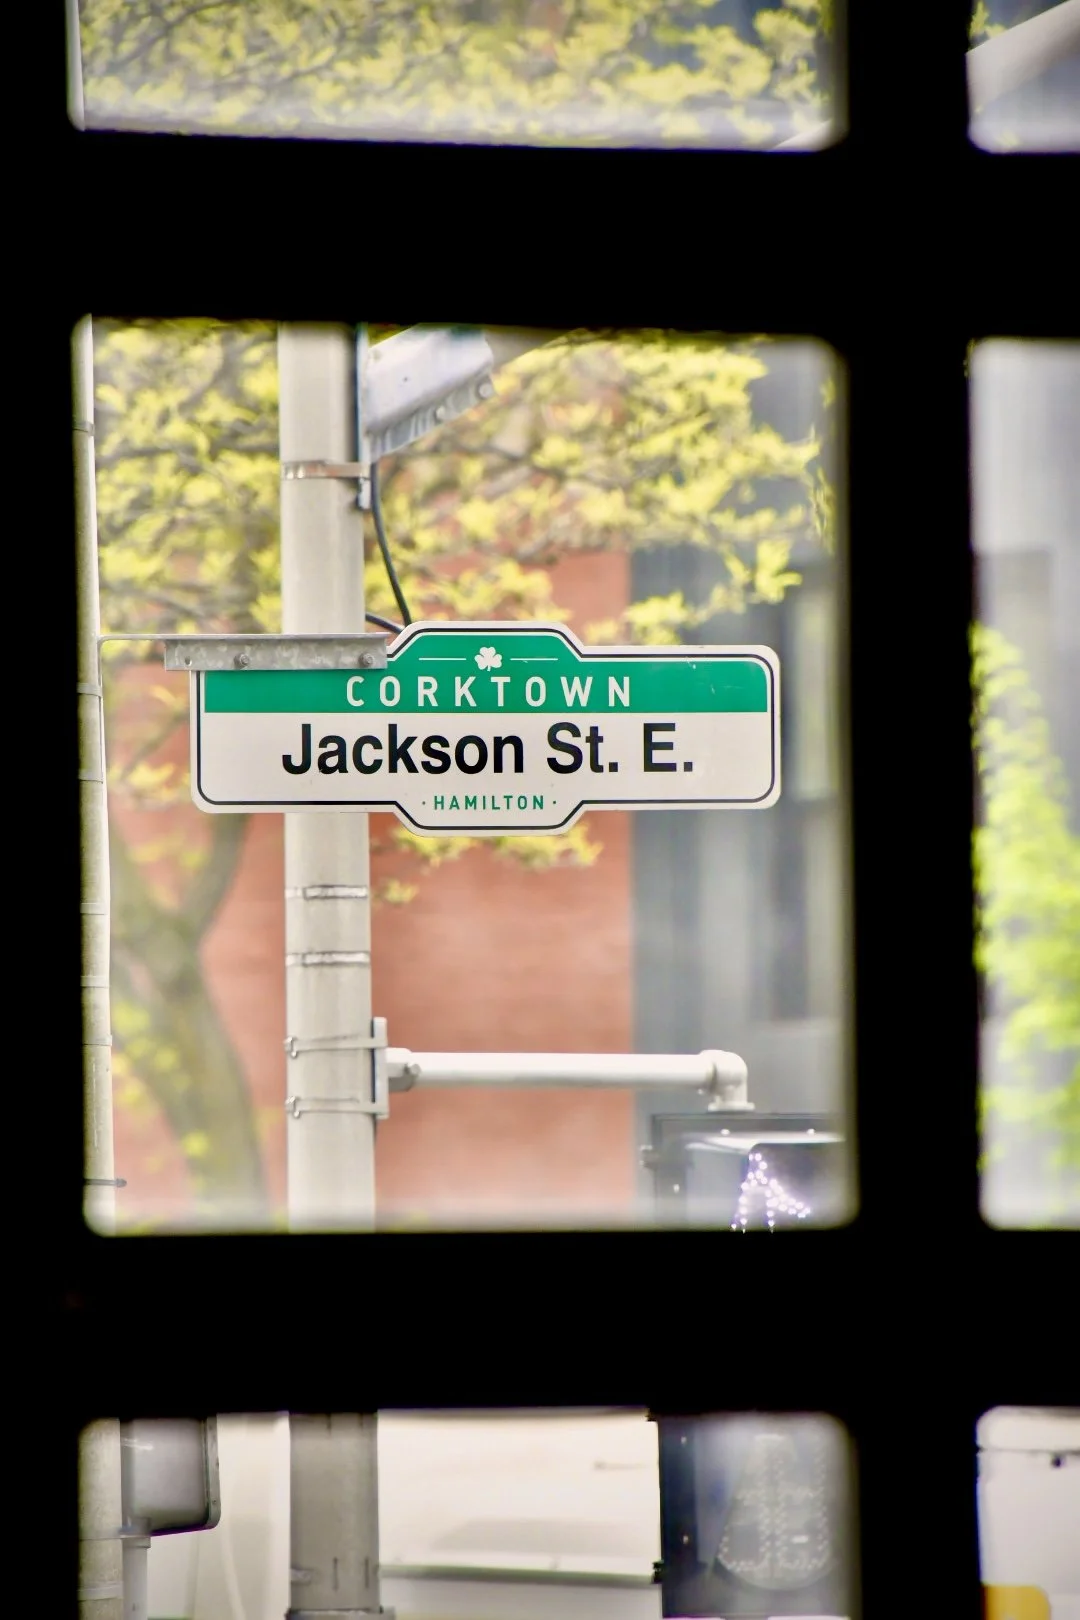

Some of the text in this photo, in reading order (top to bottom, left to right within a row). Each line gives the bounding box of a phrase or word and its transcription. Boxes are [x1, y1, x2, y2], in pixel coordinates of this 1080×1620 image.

[345, 675, 631, 708] CORKTOWN
[281, 721, 694, 776] Jackson St. E.
